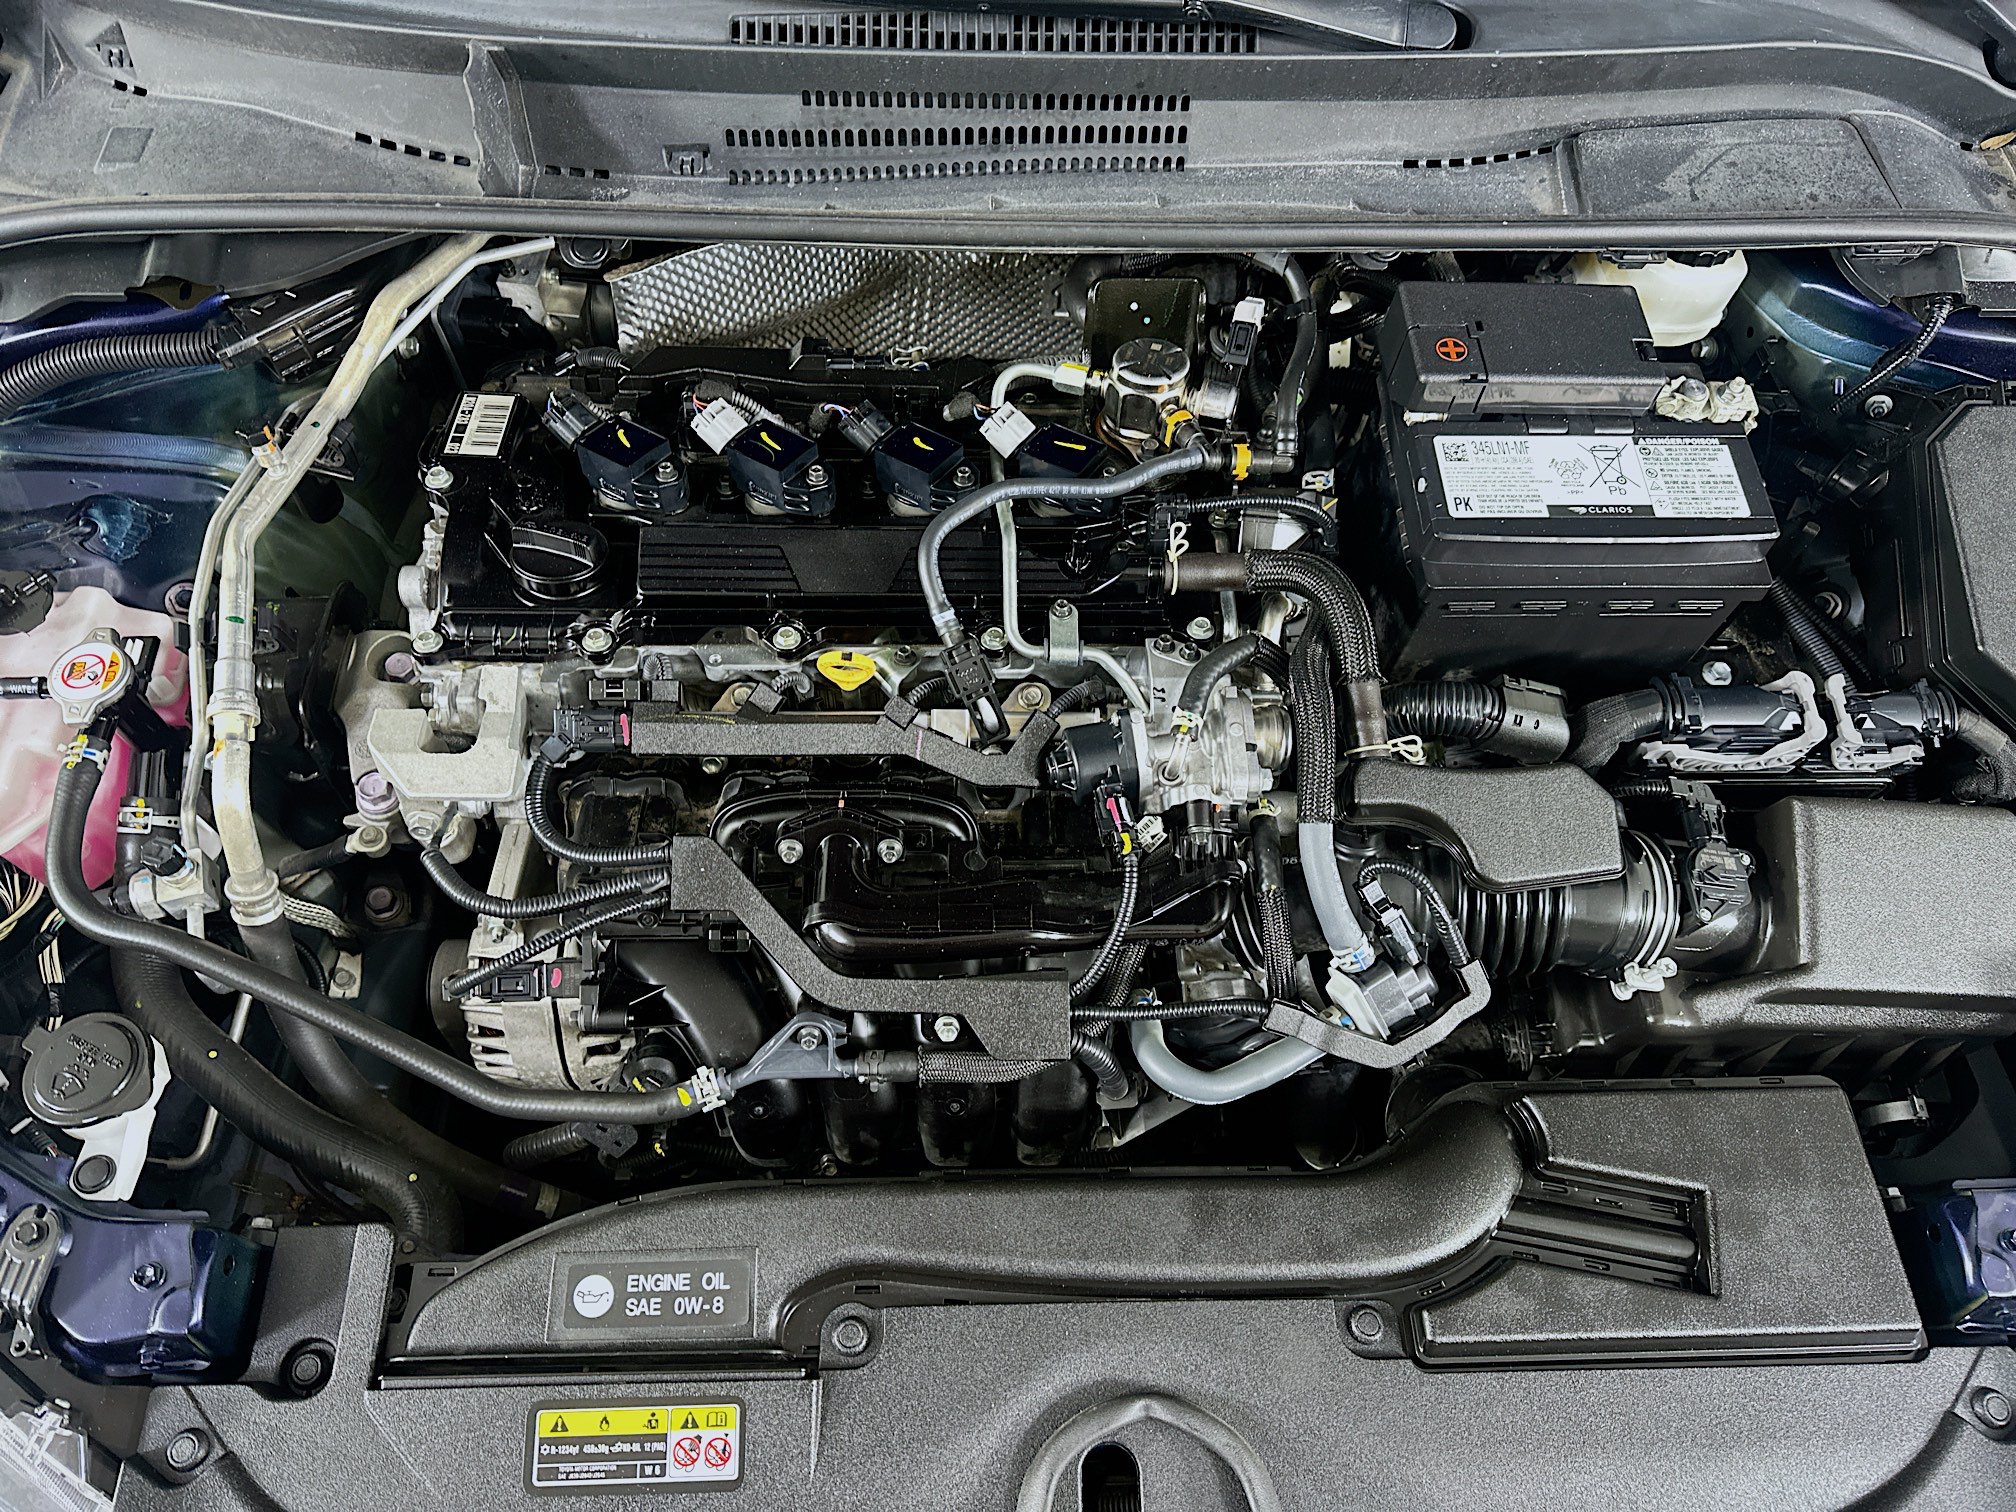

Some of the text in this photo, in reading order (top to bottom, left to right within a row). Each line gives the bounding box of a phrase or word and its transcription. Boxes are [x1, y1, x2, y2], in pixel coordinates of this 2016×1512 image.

[1471, 440, 1530, 455] 345LN1-MF
[1609, 486, 1627, 496] Pb
[1454, 497, 1473, 512] PK
[1588, 506, 1633, 514] CLARIOS
[626, 1272, 730, 1293] ENGINE OIL
[625, 1296, 725, 1317] SAE 0W-8
